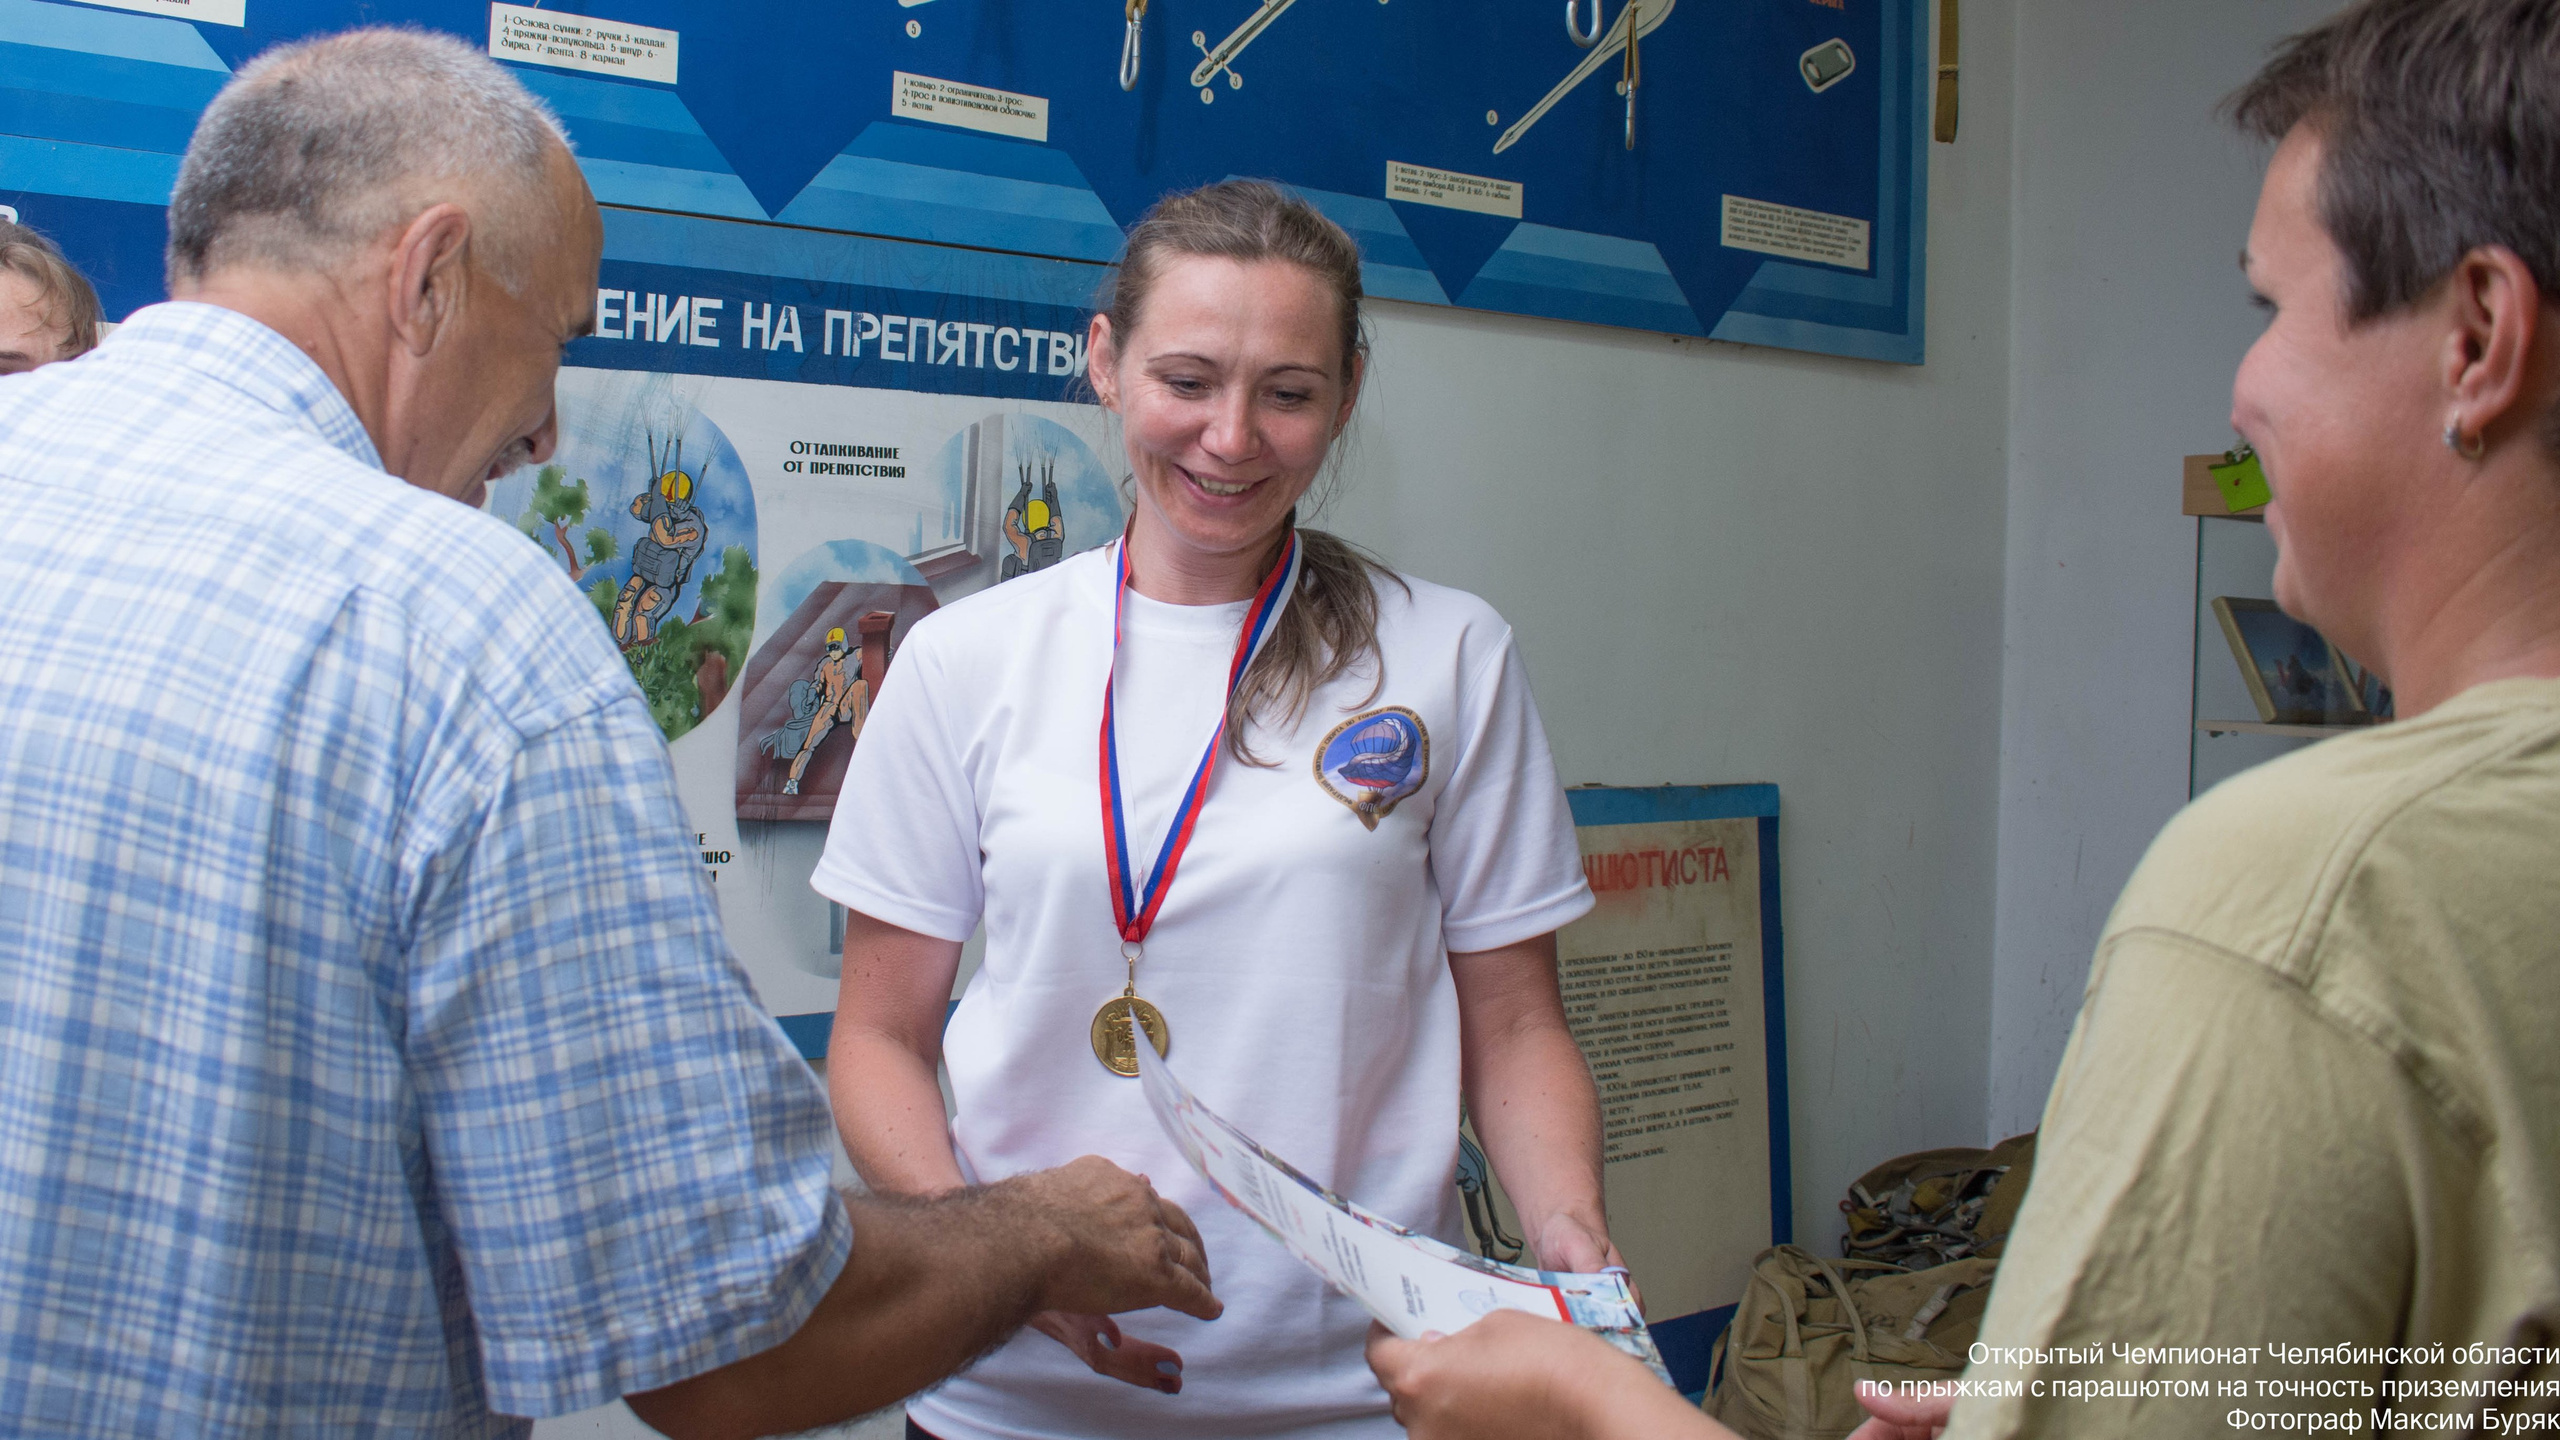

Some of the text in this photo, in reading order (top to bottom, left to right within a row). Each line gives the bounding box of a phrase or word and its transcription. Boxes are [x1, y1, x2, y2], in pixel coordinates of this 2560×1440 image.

[588, 288, 723, 348] ЕНИЕ
[742, 301, 803, 353] НА
[783, 460, 906, 478] ОТ ПРЕПЯТСТВИЯ
